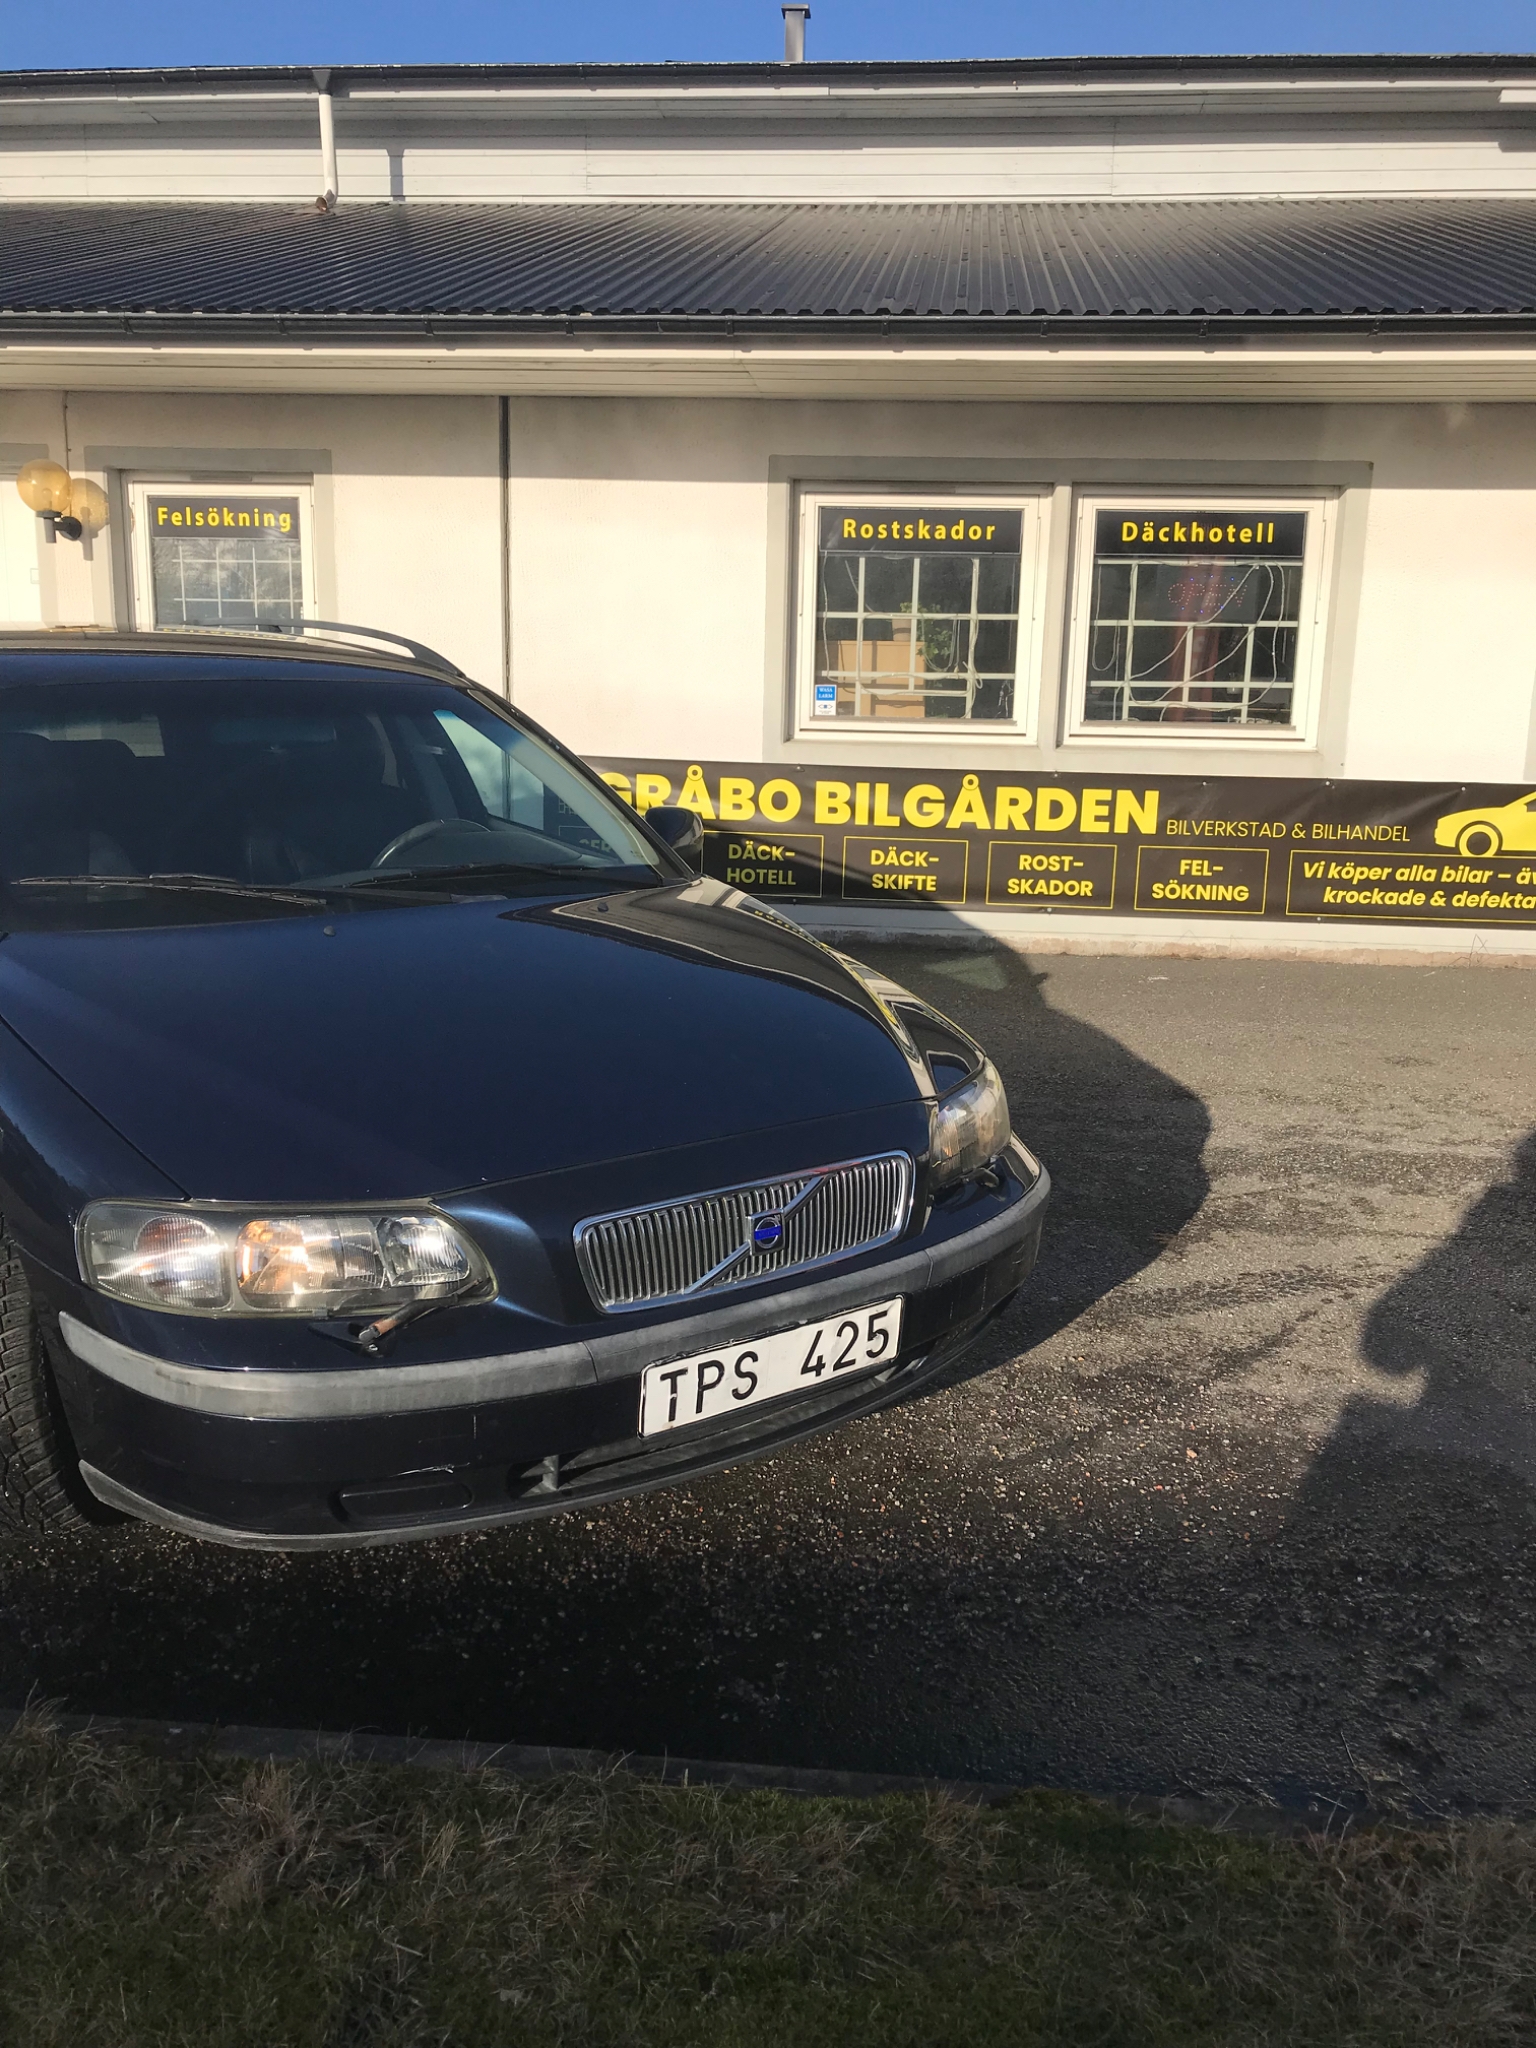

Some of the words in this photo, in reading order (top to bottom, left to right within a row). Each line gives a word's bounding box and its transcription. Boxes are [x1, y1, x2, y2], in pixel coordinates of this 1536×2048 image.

[157, 506, 291, 532] Felsökning
[843, 518, 996, 541] Rostskador
[1121, 521, 1275, 543] Däckhotell
[597, 764, 802, 823] GRÅBO
[814, 773, 1160, 836] BILGÅRDEN
[1166, 819, 1287, 838] BILVERKSTAD
[1291, 823, 1306, 839] &
[1312, 823, 1411, 842] BILHANDEL
[728, 840, 796, 861] DÄCK-
[870, 846, 940, 868] DÄCK-
[1019, 854, 1084, 872] ROST-
[1180, 860, 1224, 876] FEL-
[1304, 861, 1325, 878] Vi
[1327, 862, 1392, 885] köper
[1395, 864, 1437, 882] alla
[1441, 864, 1493, 884] bilar
[726, 867, 797, 885] HOTELL
[871, 873, 938, 892] SKIFTE
[1007, 878, 1094, 897] SKADOR
[1152, 879, 1250, 902] SÖKNING
[1323, 886, 1426, 906] krockade
[1430, 890, 1447, 907] &
[1452, 890, 1536, 909] defekta
[659, 1351, 759, 1422] TPS
[800, 1310, 890, 1378] 425
